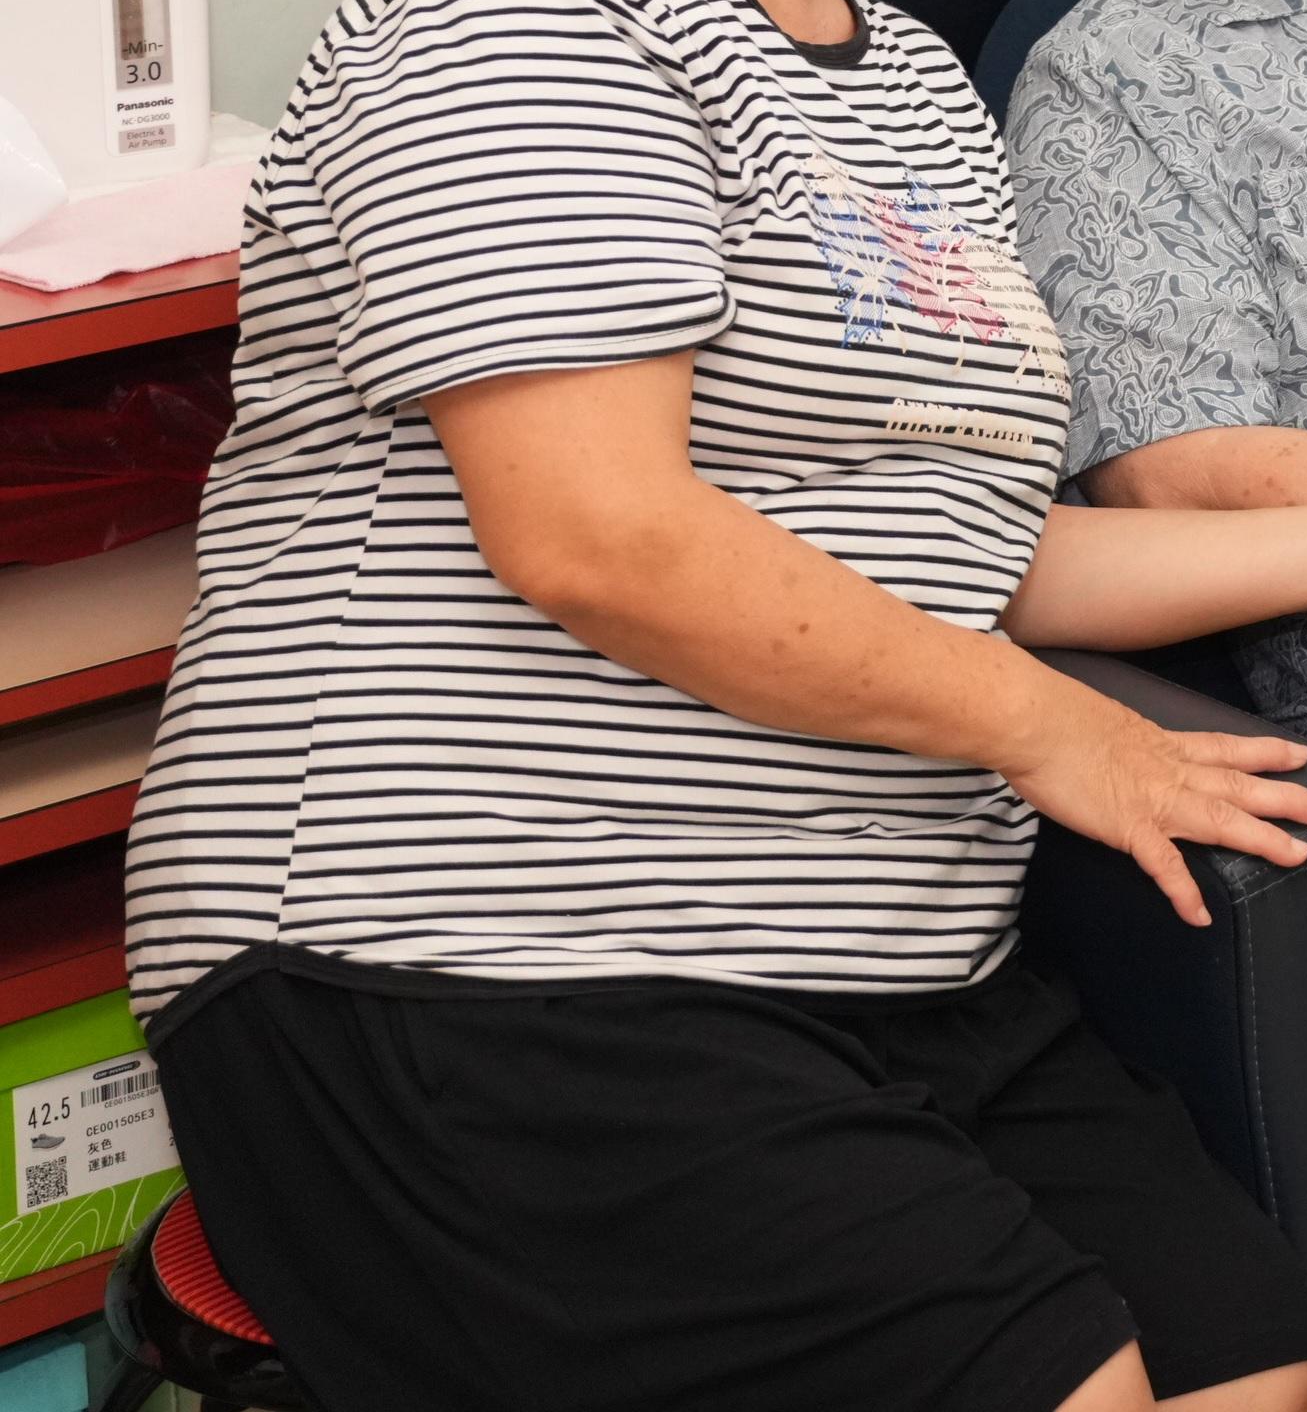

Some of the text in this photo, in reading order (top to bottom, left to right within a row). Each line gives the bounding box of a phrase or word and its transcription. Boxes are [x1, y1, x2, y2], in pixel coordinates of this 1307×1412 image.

[126, 61, 162, 84] 3.0
[117, 97, 174, 113] Panasonic
[127, 129, 156, 140] Electric
[128, 137, 168, 150] Air Pump
[27, 1096, 71, 1130] 42.5
[86, 1108, 155, 1137] CE001505E3
[87, 1138, 112, 1155] 灰色
[88, 1150, 127, 1173] 運動鞋
